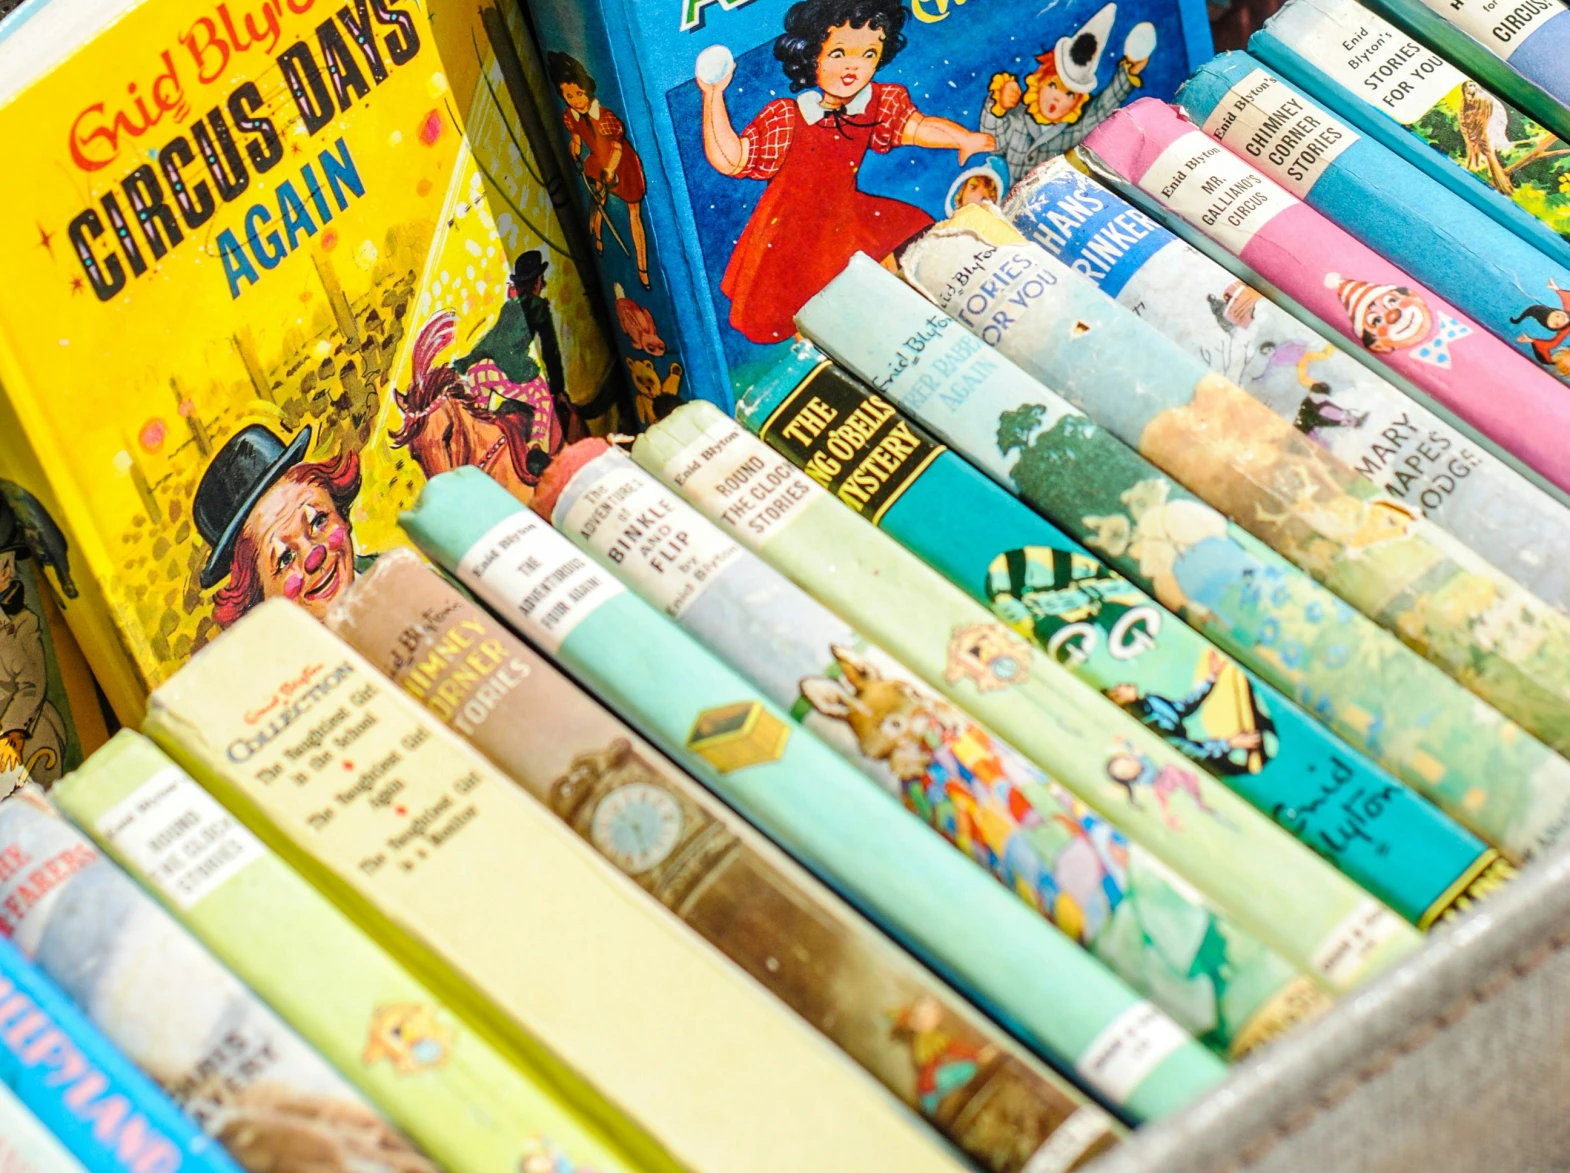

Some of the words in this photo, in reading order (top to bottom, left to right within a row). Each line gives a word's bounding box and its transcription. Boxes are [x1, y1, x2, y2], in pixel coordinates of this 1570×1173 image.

[1341, 27, 1369, 52] Enid
[1347, 30, 1393, 70] Blyton's
[1364, 42, 1421, 91] STORIES
[1382, 81, 1415, 108] FOR
[1411, 55, 1444, 84] YOU
[69, 50, 191, 172] Enid
[1213, 113, 1237, 142] Enid
[1234, 76, 1278, 113] Blyton's
[1245, 98, 1304, 158] CHIMNEY
[1268, 114, 1321, 167] CORNER
[1287, 127, 1343, 182] STORIES
[67, 81, 284, 303] CIRCUS
[1161, 170, 1187, 200] Enid
[1184, 146, 1221, 172] Blyton
[1201, 174, 1227, 196] MR.
[1201, 173, 1262, 227] GALLIANO'S
[215, 136, 367, 301] AGAIN
[1032, 188, 1104, 256] HANS
[1227, 191, 1268, 227] CIRCUS
[1070, 208, 1162, 280] RINKER
[957, 253, 1032, 328] TORIES
[981, 310, 1016, 347] OR
[1008, 268, 1058, 309] YOU
[871, 351, 909, 394] Enid
[903, 373, 942, 410] RER
[938, 357, 999, 413] AGAIN
[782, 396, 839, 448] THE
[1354, 412, 1418, 482] MARY
[674, 460, 702, 487] Enid
[715, 455, 765, 498] ROUND
[804, 449, 842, 489] NG
[1420, 448, 1483, 518] ODGE
[579, 478, 645, 541] ADVENTURES
[607, 499, 676, 566] BINKLE
[720, 496, 757, 527] THE
[748, 480, 810, 534] STORIES
[472, 549, 502, 579] Enid
[517, 555, 544, 578] THE
[639, 524, 673, 558] AND
[650, 531, 690, 574] FLIP
[426, 638, 511, 722] ORNER
[454, 656, 532, 735] TORIES
[1319, 785, 1406, 854] lyton
[0, 841, 98, 940] FARERS
